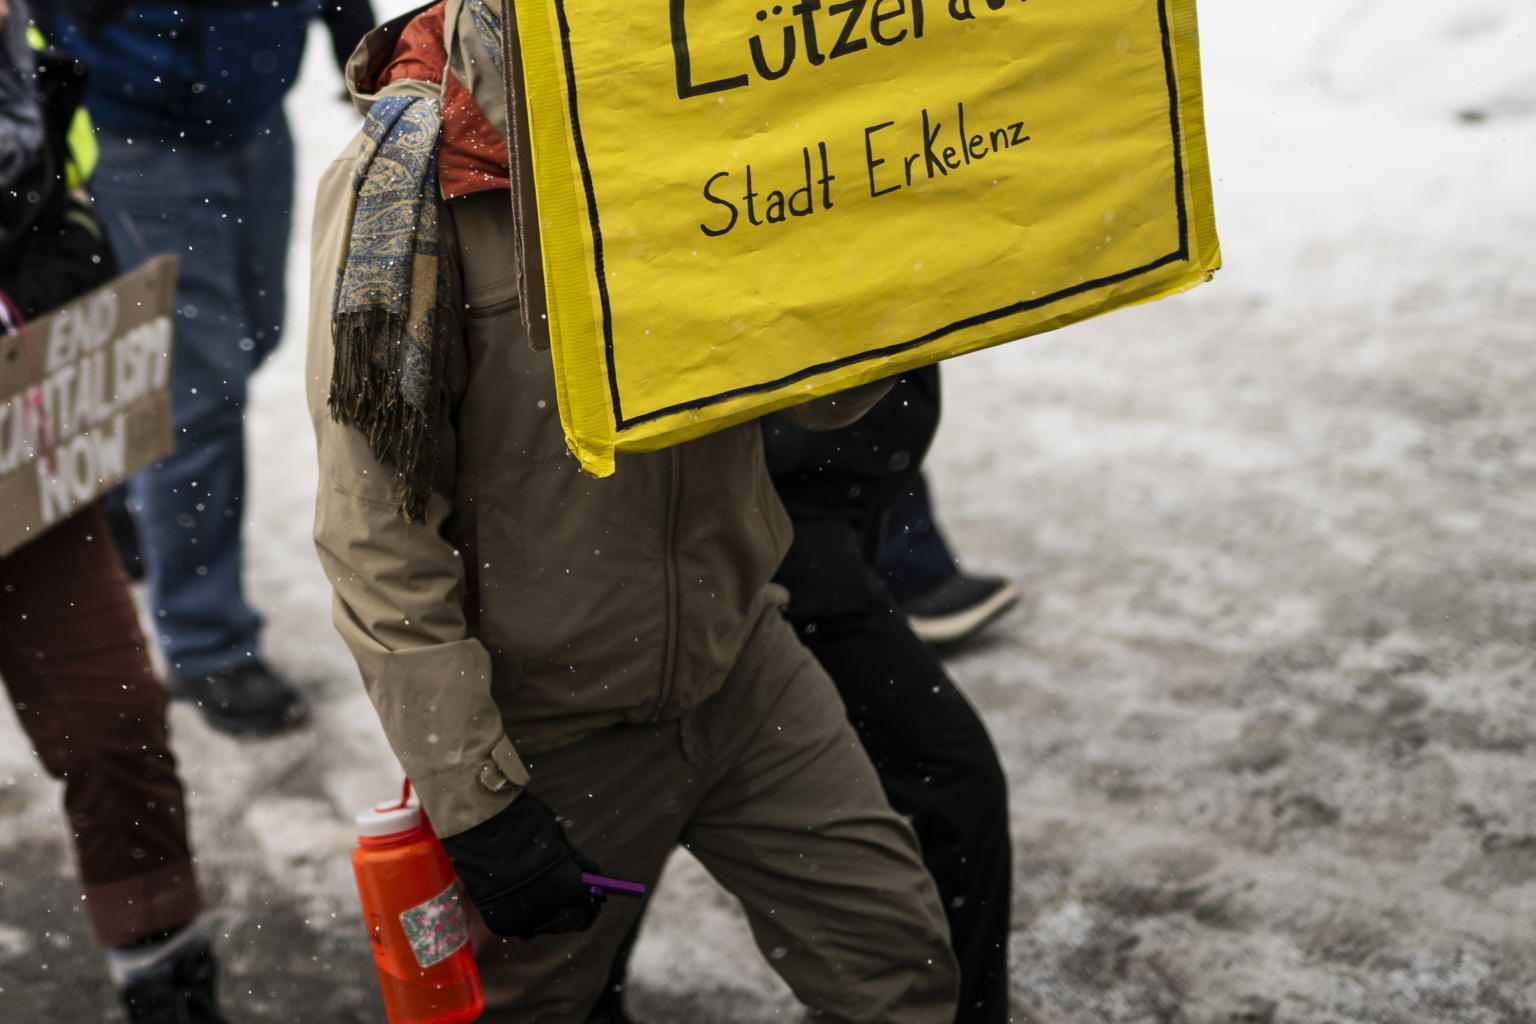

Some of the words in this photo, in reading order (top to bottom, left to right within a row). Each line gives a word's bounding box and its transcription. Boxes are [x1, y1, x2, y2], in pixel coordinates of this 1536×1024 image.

[700, 142, 836, 238] Stadt
[44, 288, 118, 374] END
[37, 414, 126, 523] NOW
